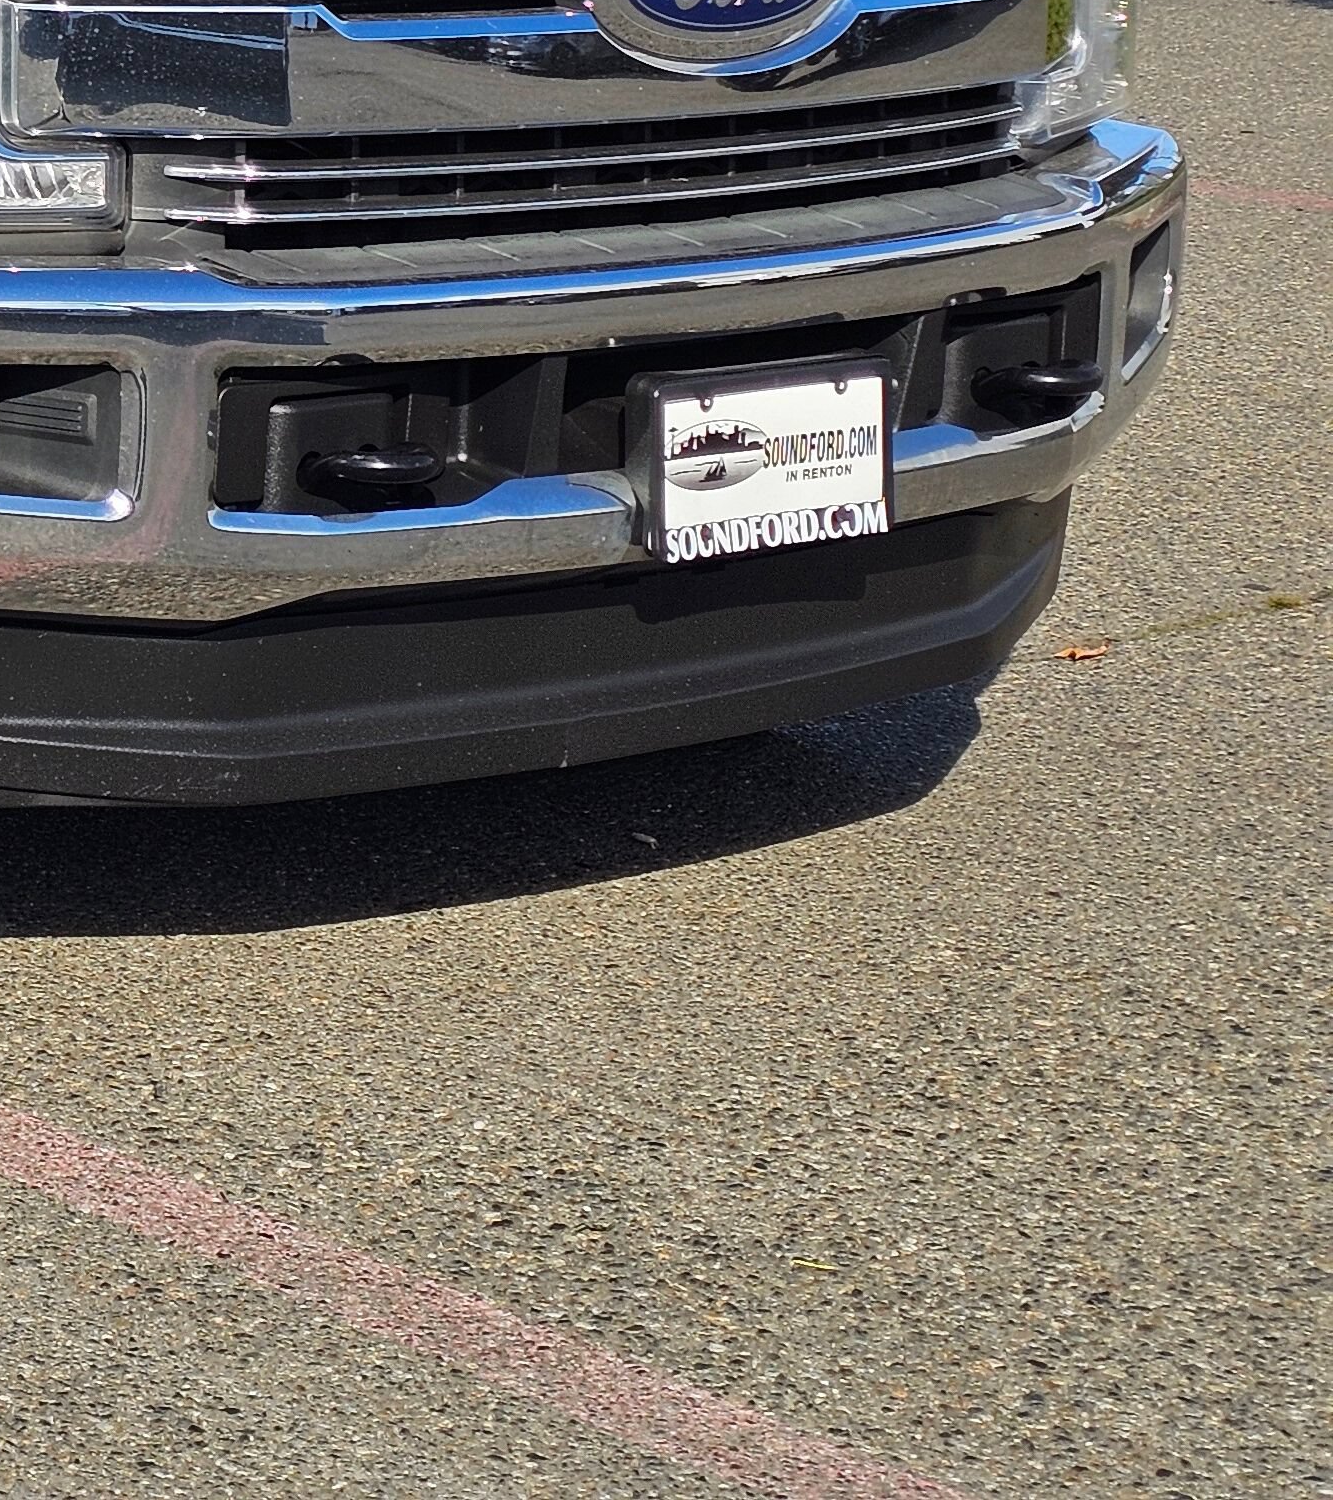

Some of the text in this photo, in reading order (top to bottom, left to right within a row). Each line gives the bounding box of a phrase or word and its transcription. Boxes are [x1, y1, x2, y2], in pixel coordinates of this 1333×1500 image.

[762, 424, 878, 470] SOUNDFORD.COM
[785, 464, 853, 484] IN RENTON
[665, 500, 889, 565] SOUNDFORD.COM
